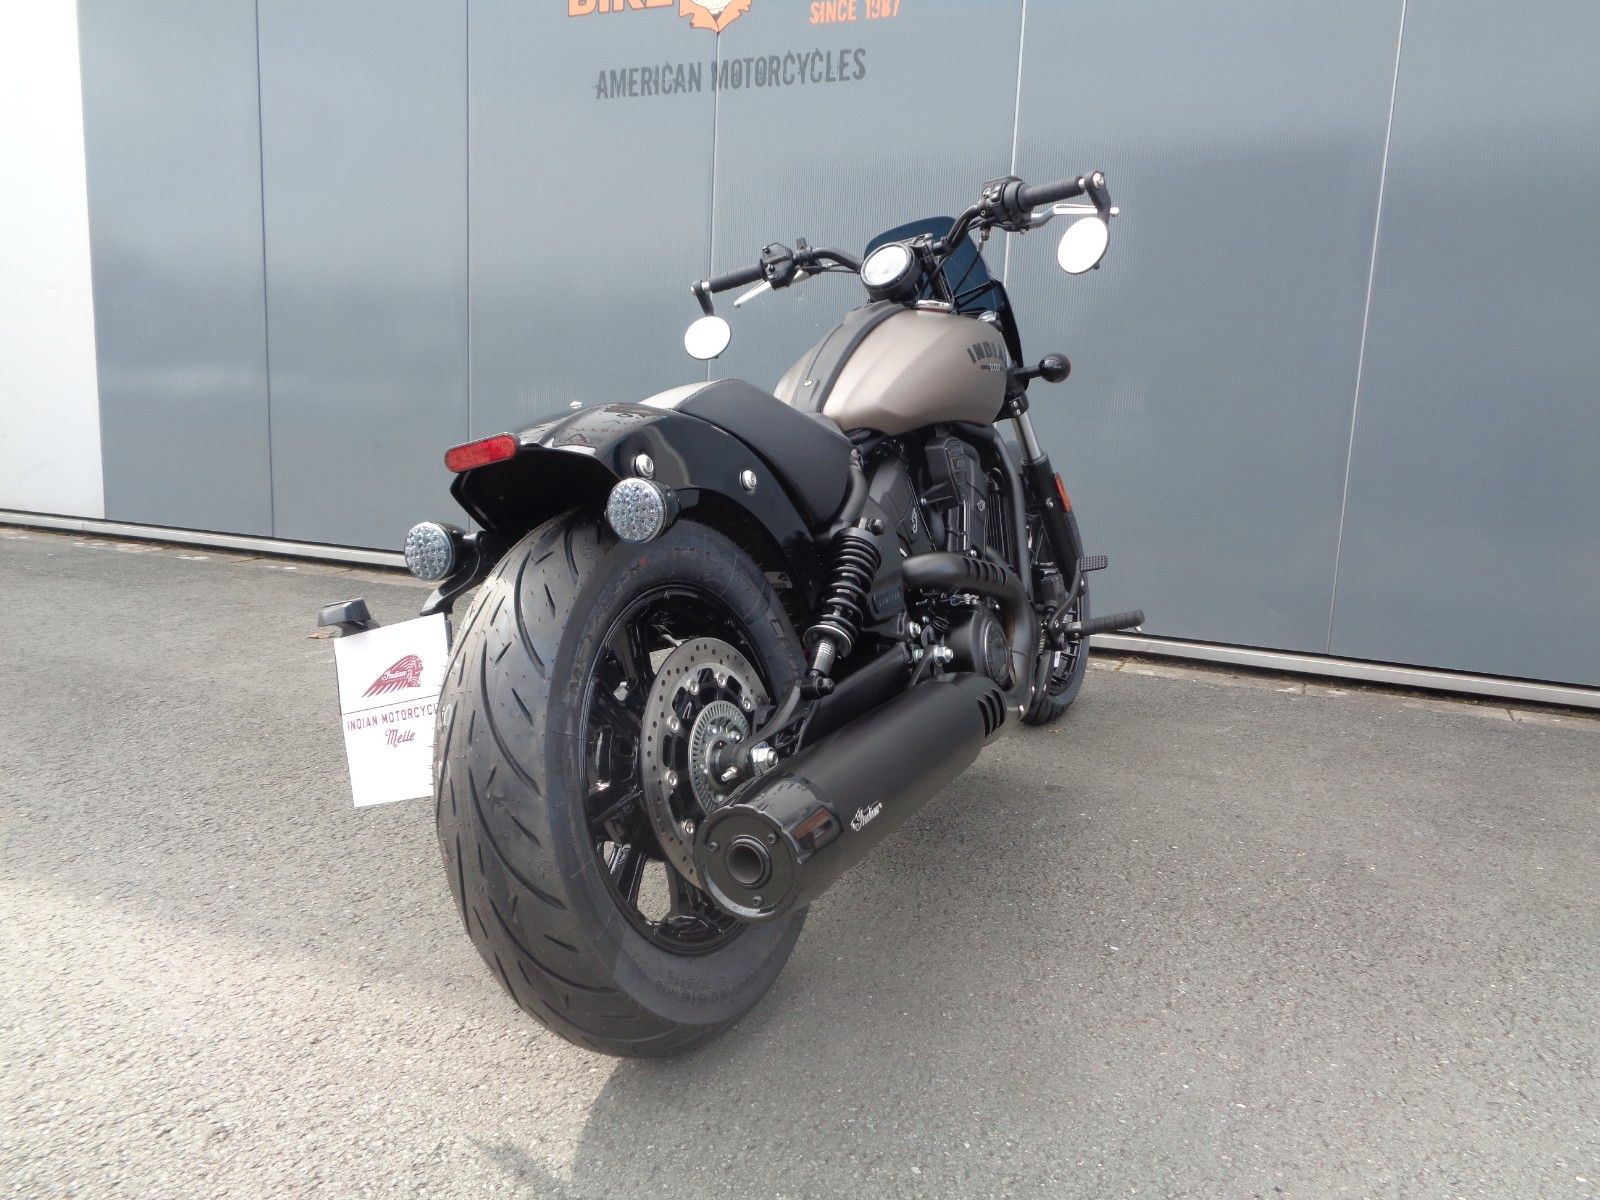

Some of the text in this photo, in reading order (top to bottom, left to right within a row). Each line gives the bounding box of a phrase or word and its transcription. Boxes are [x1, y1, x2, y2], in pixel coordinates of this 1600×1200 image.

[810, 0, 857, 24] SINCE
[596, 48, 866, 100] AMERICAN MOTORCYCLES
[347, 703, 438, 731] INDIAN MOTORCYCL
[385, 729, 415, 748] Melle
